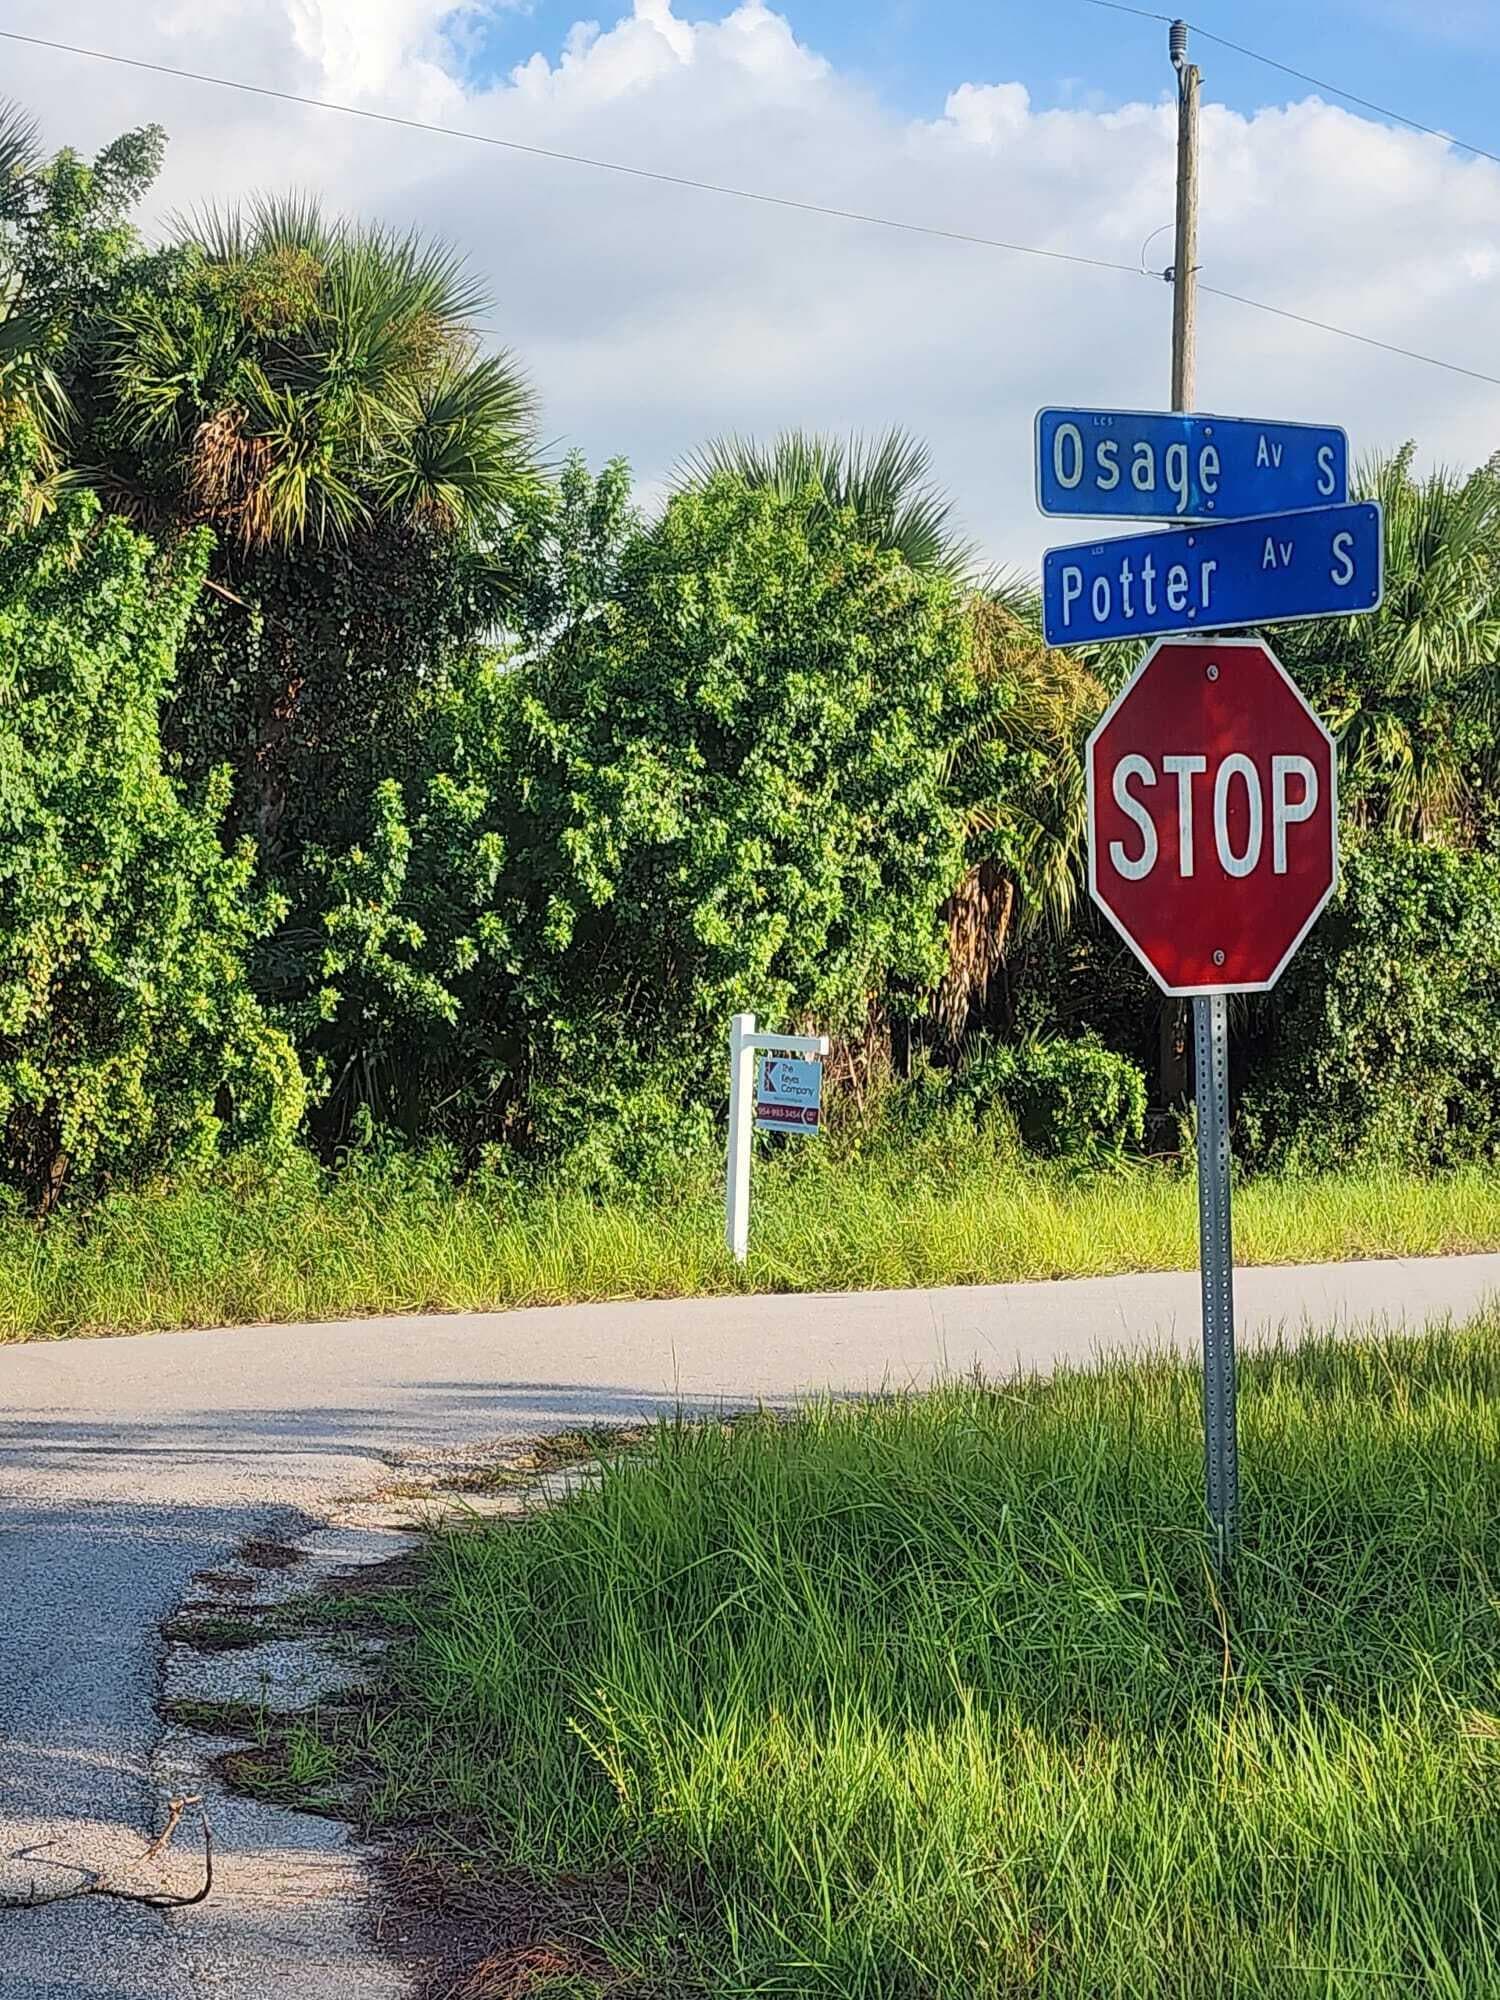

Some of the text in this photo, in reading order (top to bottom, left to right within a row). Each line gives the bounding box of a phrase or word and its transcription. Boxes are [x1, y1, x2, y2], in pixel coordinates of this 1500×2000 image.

[1053, 423, 1336, 514] Osage Av S
[1062, 532, 1355, 626] Potter Av S
[1109, 753, 1319, 881] STOP
[780, 1084, 816, 1097] Company
